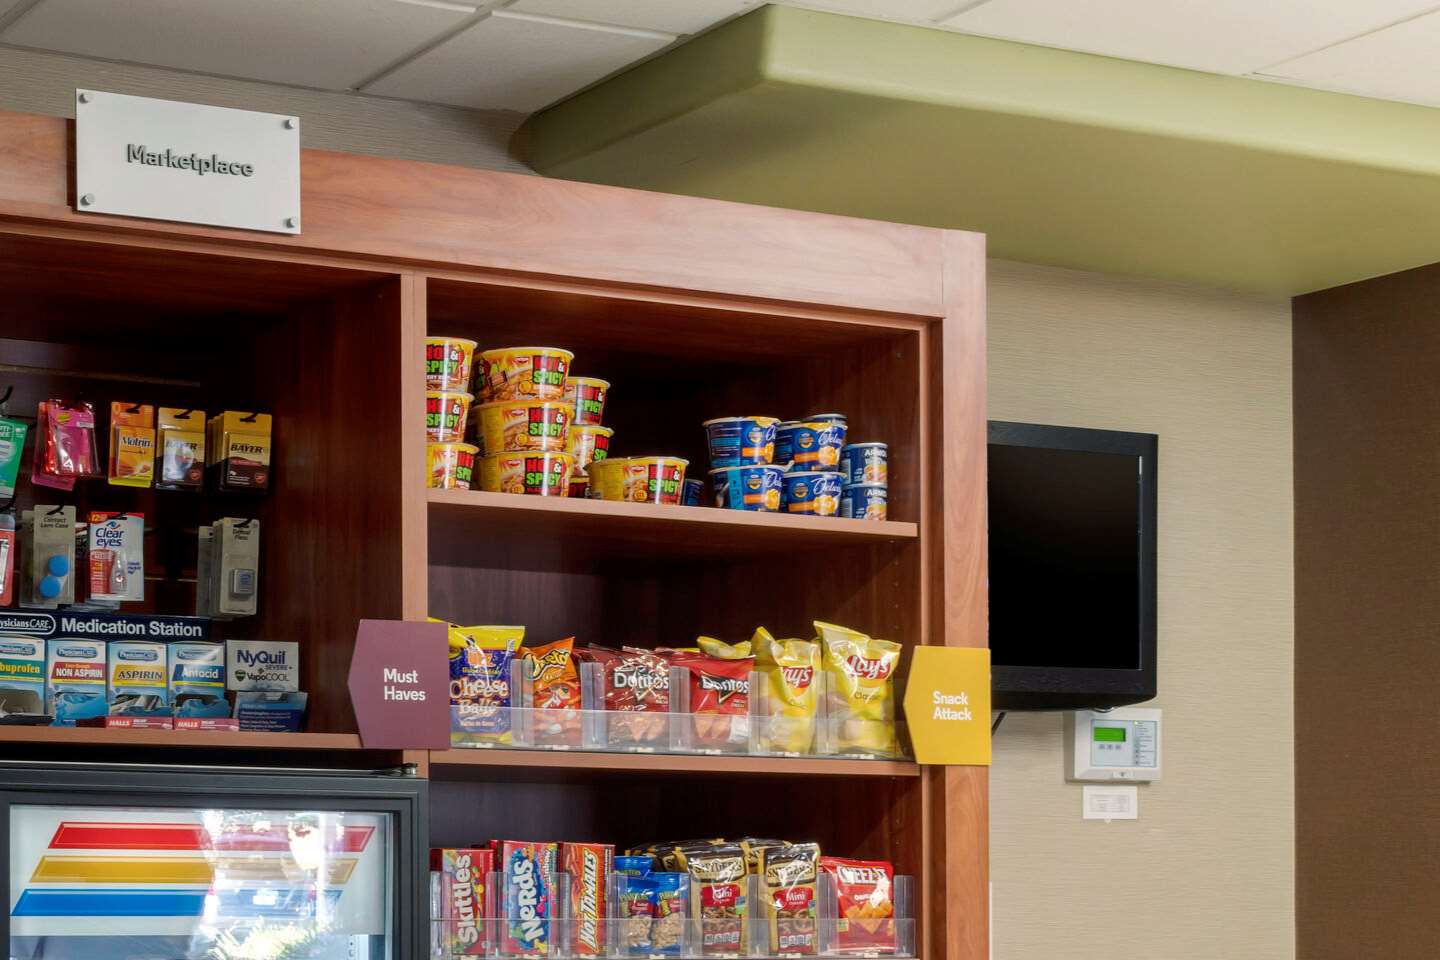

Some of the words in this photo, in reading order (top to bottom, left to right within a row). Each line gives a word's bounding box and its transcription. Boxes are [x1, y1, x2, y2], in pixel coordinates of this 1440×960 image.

[126, 143, 254, 177] Marketplace
[231, 442, 264, 454] BAYER
[43, 516, 67, 524] Contact
[95, 527, 125, 539] Clear
[96, 536, 122, 548] eyes
[61, 617, 146, 635] Medication
[149, 620, 203, 637] Station
[236, 649, 286, 668] NyQuil
[56, 668, 74, 678] NON
[74, 669, 103, 679] ASPIRIN
[118, 669, 163, 680] ASPIRIN
[383, 668, 419, 684] Must
[449, 680, 509, 700] Cheese
[702, 676, 750, 694] Doritos
[383, 686, 426, 702] Haves
[932, 691, 969, 706] Snack
[932, 707, 973, 721] Attack
[177, 720, 199, 728] HALLS
[581, 848, 598, 912] TAMALES
